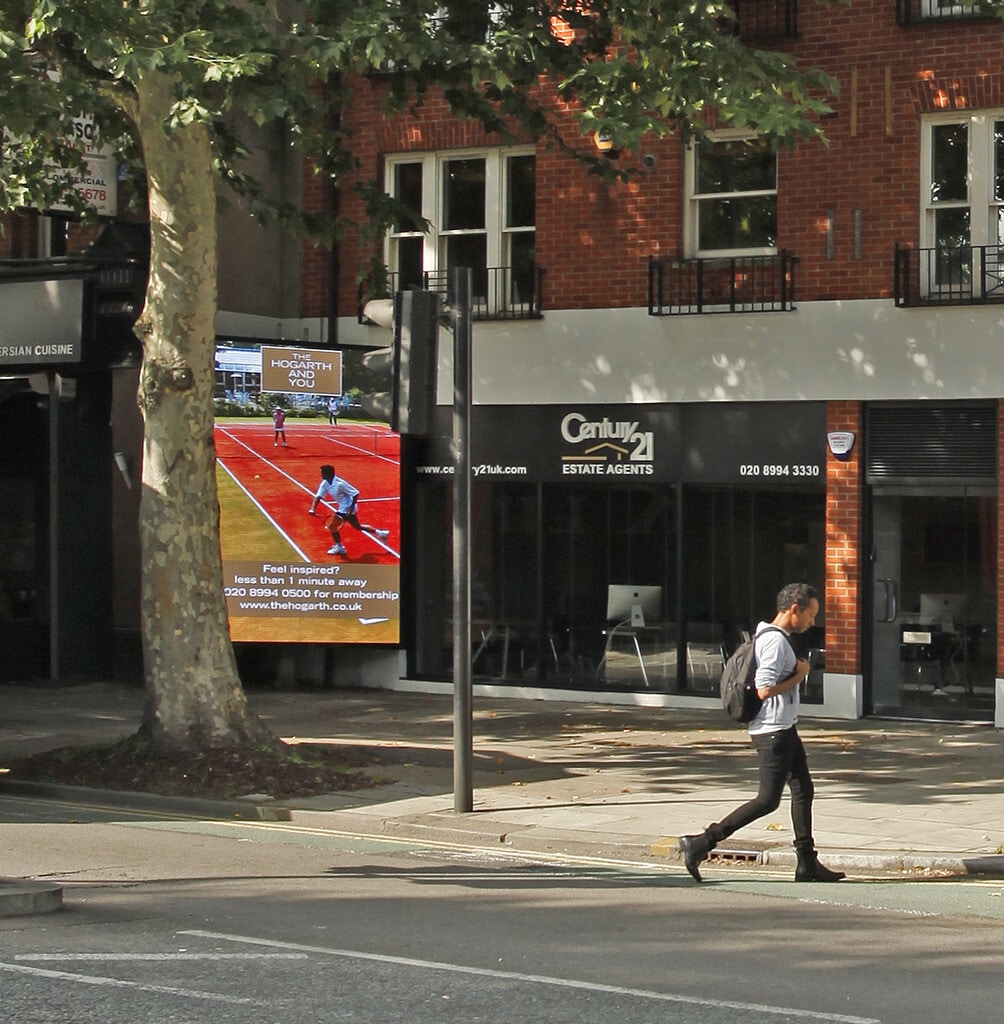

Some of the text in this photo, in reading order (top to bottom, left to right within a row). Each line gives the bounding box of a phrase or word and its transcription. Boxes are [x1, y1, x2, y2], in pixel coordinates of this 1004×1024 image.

[34, 343, 74, 356] CUISINE
[292, 353, 312, 361] THE
[271, 359, 332, 371] HOGARTH
[288, 370, 315, 379] AND
[288, 378, 315, 388] YOU
[561, 412, 654, 461] Century 21
[562, 464, 654, 475] ESTATE AGENTS
[740, 465, 760, 476] 020
[763, 465, 789, 476] 8994
[792, 465, 820, 476] 3330
[263, 564, 340, 575] Feel inspired?
[234, 575, 368, 588] less than 1 minute away
[249, 588, 278, 598] 8994
[282, 588, 312, 598] 0500
[314, 589, 330, 598] for
[333, 591, 399, 601] membership
[239, 601, 363, 612] www.thehogarth.co.uk
